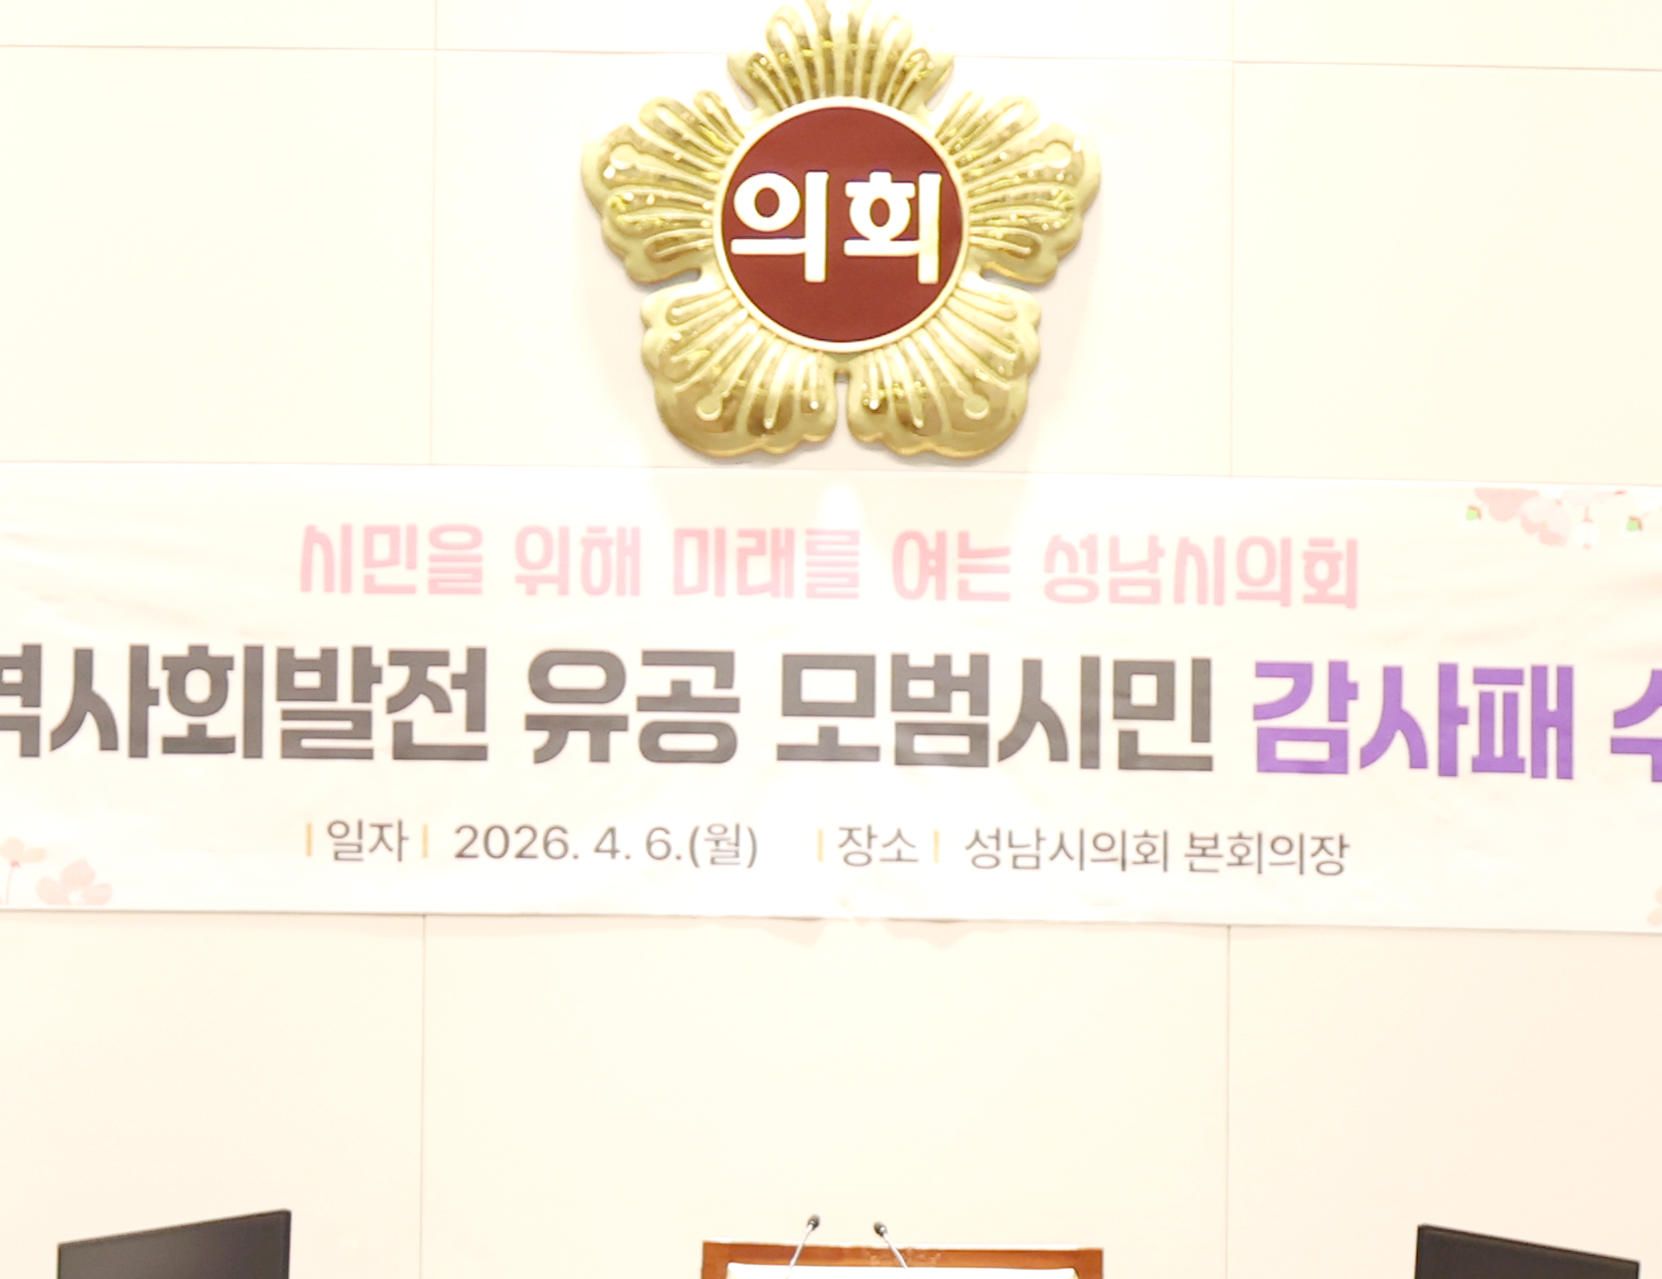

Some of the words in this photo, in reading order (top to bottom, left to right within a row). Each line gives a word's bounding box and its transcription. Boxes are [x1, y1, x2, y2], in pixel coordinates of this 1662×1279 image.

[731, 170, 942, 284] 의회
[299, 523, 484, 595] 시민을
[513, 525, 642, 597] 위해
[673, 527, 860, 600] 미래를
[891, 529, 1011, 603] 여는
[1042, 533, 1359, 610] 성남시의회
[525, 650, 741, 766] 유공
[776, 654, 1215, 774] 모범시민
[1253, 661, 1575, 782] 감사패
[326, 820, 408, 864] 일자
[455, 825, 580, 862] 2026.
[594, 827, 632, 862] 4.
[646, 825, 759, 870] 6.(월)
[838, 824, 921, 867] 장소
[965, 829, 1171, 874] 성남시의회
[1186, 832, 1352, 878] 본회의장
